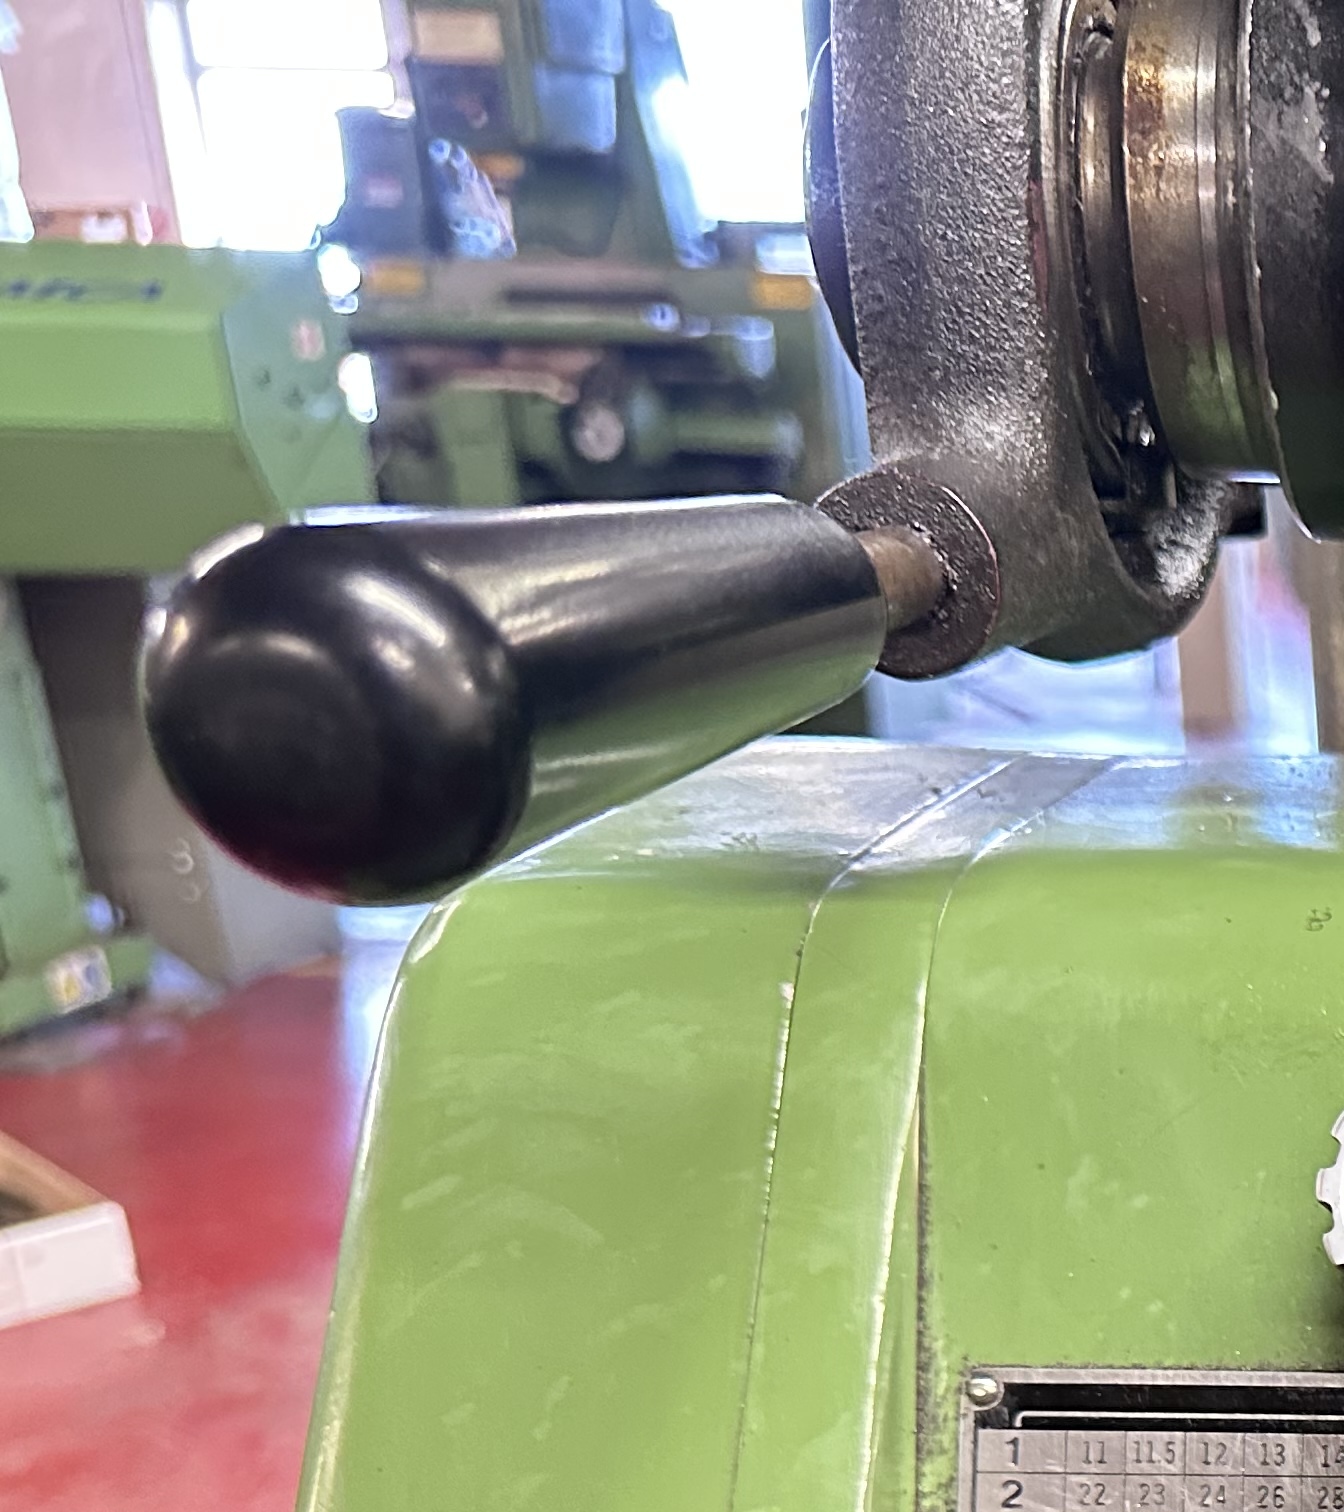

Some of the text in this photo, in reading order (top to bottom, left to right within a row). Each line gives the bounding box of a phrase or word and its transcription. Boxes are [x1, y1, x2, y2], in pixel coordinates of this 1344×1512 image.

[1005, 1437, 1019, 1466] 1
[1082, 1441, 1107, 1464] 11
[1133, 1440, 1176, 1464] 11.5
[1201, 1442, 1227, 1466] 12
[1261, 1442, 1286, 1466] 13
[1000, 1480, 1024, 1508] 2
[1080, 1483, 1107, 1506] 22
[1138, 1483, 1166, 1506] 23
[1200, 1484, 1226, 1507] 24
[1257, 1485, 1285, 1508] 26
[1317, 1486, 1344, 1510] 28
